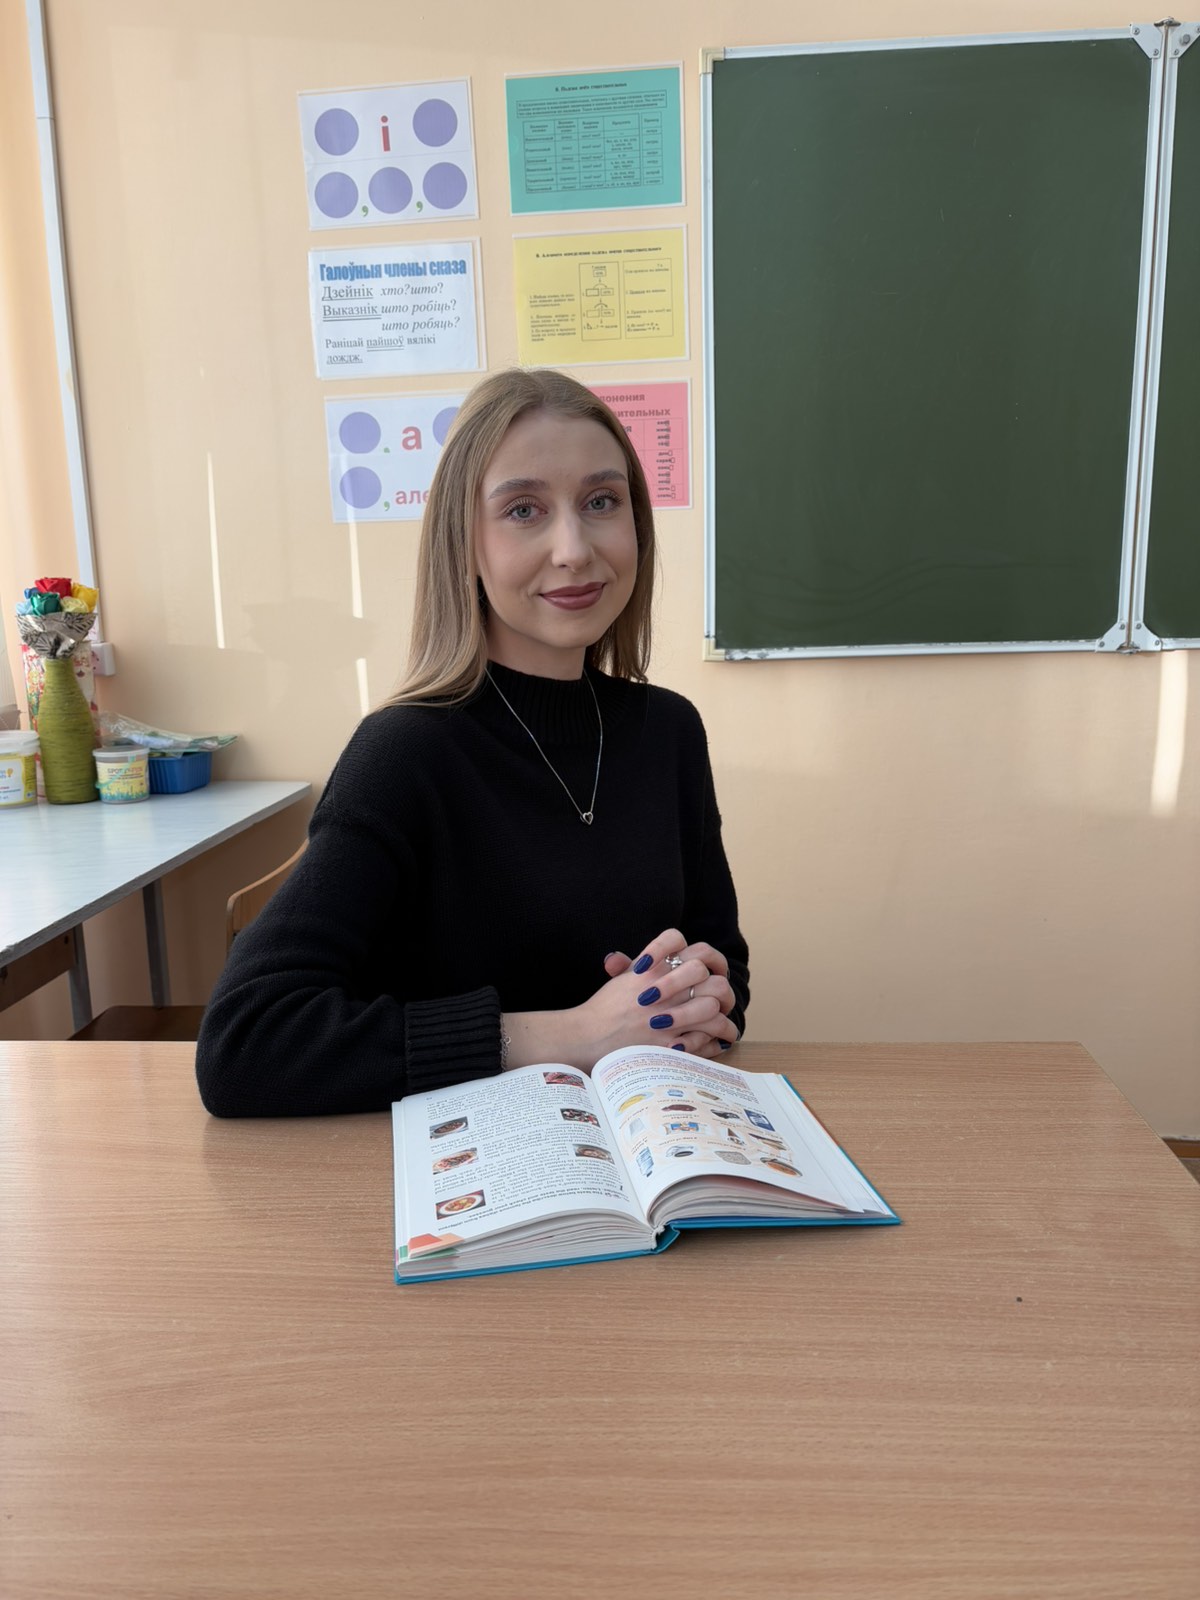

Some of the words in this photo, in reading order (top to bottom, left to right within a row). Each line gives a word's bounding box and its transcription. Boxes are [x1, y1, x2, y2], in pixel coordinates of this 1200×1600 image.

[380, 115, 391, 152] і
[319, 261, 382, 282] Галоўныя
[384, 261, 427, 278] члены
[430, 258, 467, 275] сказа
[321, 284, 374, 301] Дзейнік
[322, 303, 378, 318] Выказнік
[381, 304, 409, 315] што
[411, 299, 457, 317] робіць?
[381, 321, 409, 332] што
[412, 316, 461, 333] робяць?
[325, 337, 364, 349] Раніцай
[366, 335, 405, 349] пайшоў
[406, 333, 436, 345] вялікі
[617, 409, 671, 418] ительных
[401, 425, 422, 451] а
